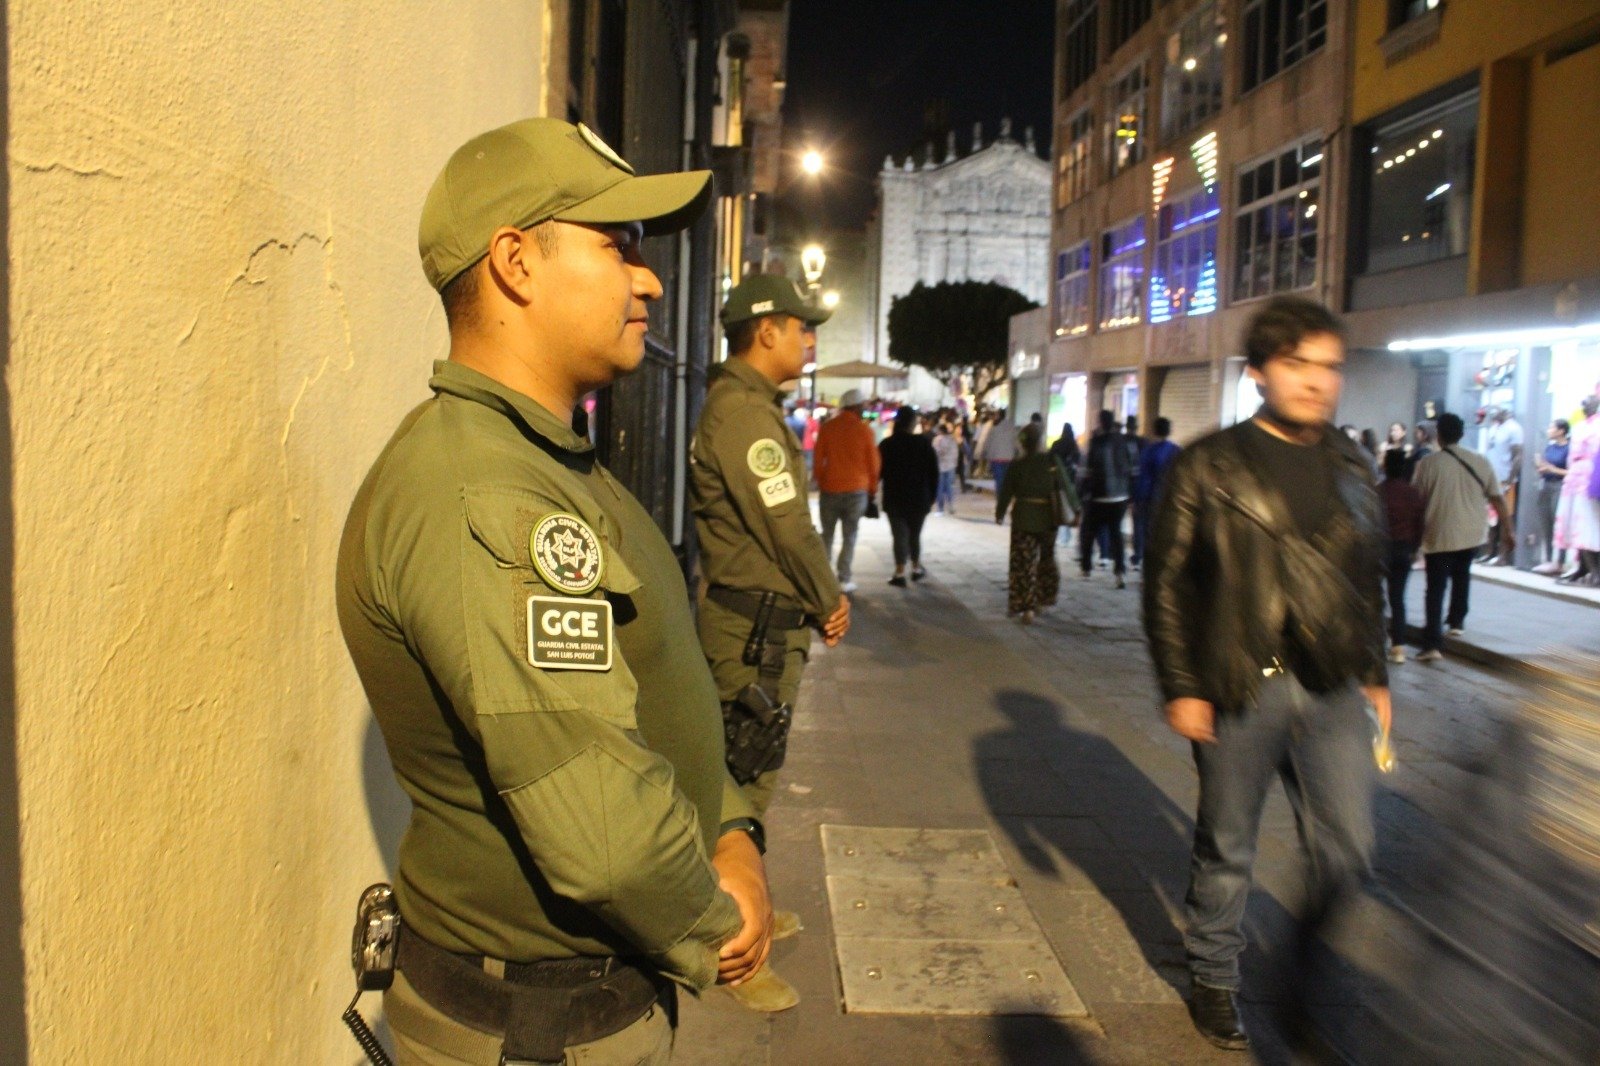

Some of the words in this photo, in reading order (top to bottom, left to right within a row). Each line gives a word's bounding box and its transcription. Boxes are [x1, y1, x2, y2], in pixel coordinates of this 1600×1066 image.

[558, 518, 579, 531] CIVIL
[541, 609, 599, 638] GCE
[537, 640, 565, 650] GUARDIA
[565, 641, 580, 650] CIVIL
[580, 642, 605, 651] ESTATAL
[546, 650, 560, 659] SAN
[560, 651, 574, 660] LUIS
